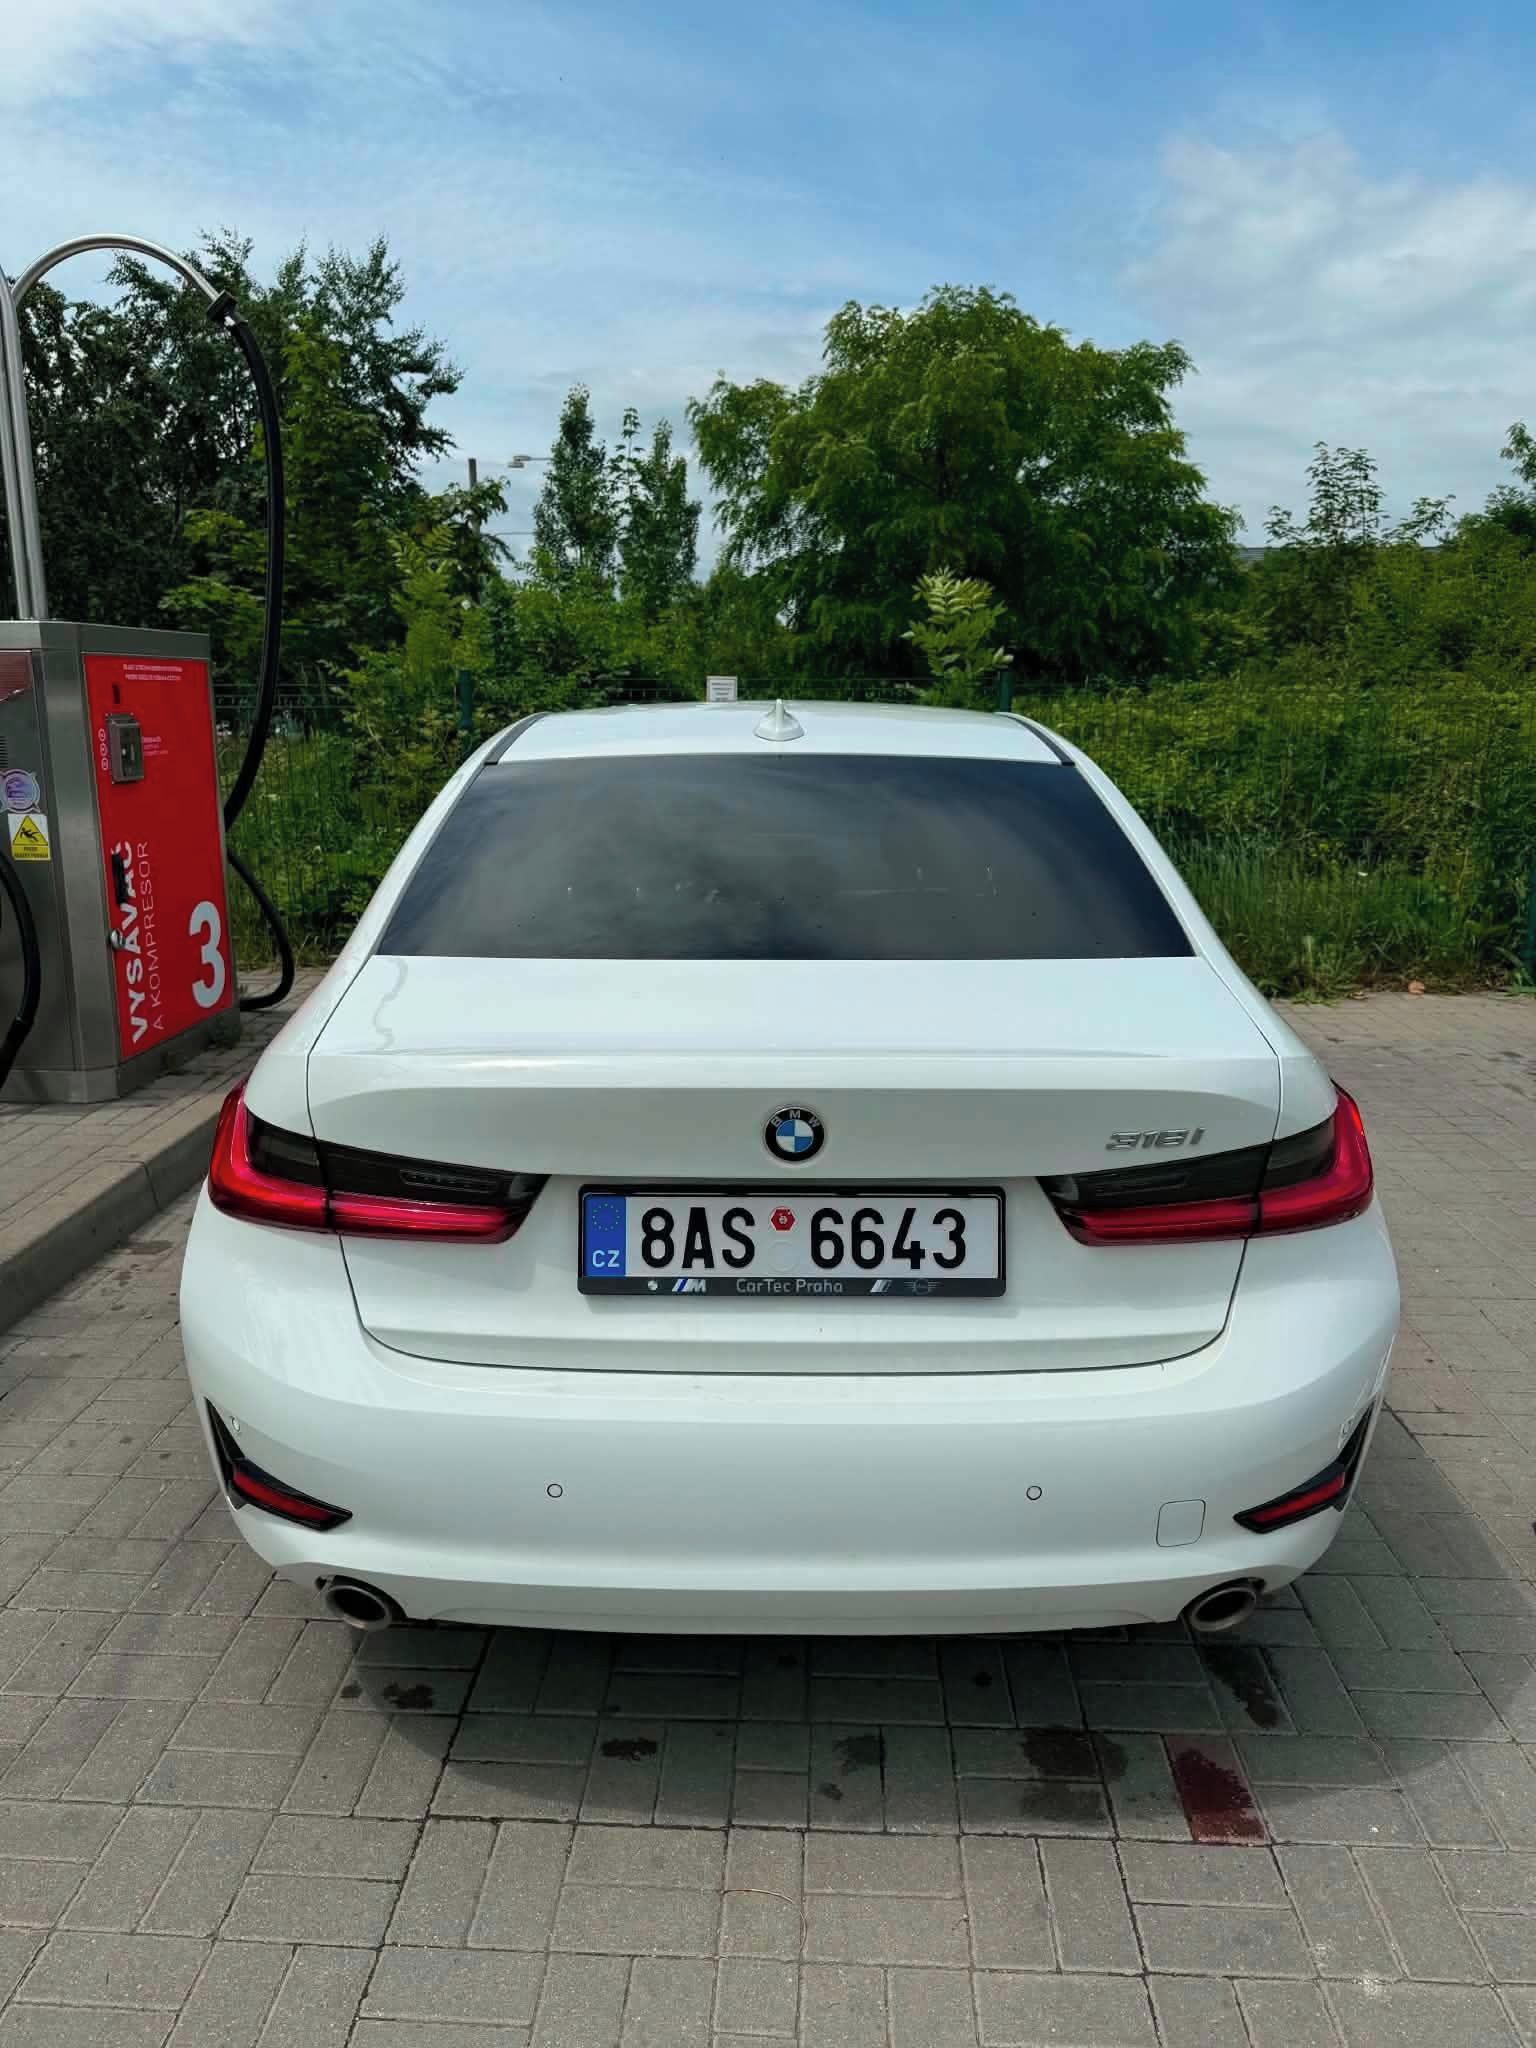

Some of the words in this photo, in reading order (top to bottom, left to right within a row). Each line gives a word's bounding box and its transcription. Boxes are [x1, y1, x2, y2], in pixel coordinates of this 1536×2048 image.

[137, 842, 161, 1008] KOMPRESOR
[189, 901, 225, 1008] 3
[153, 1014, 165, 1030] A
[770, 1110, 821, 1128] BMW
[641, 1207, 755, 1268] 8AS
[811, 1207, 966, 1269] 6643
[592, 1250, 620, 1268] CZ
[736, 1279, 791, 1293] CarTec
[796, 1279, 843, 1293] Praha
